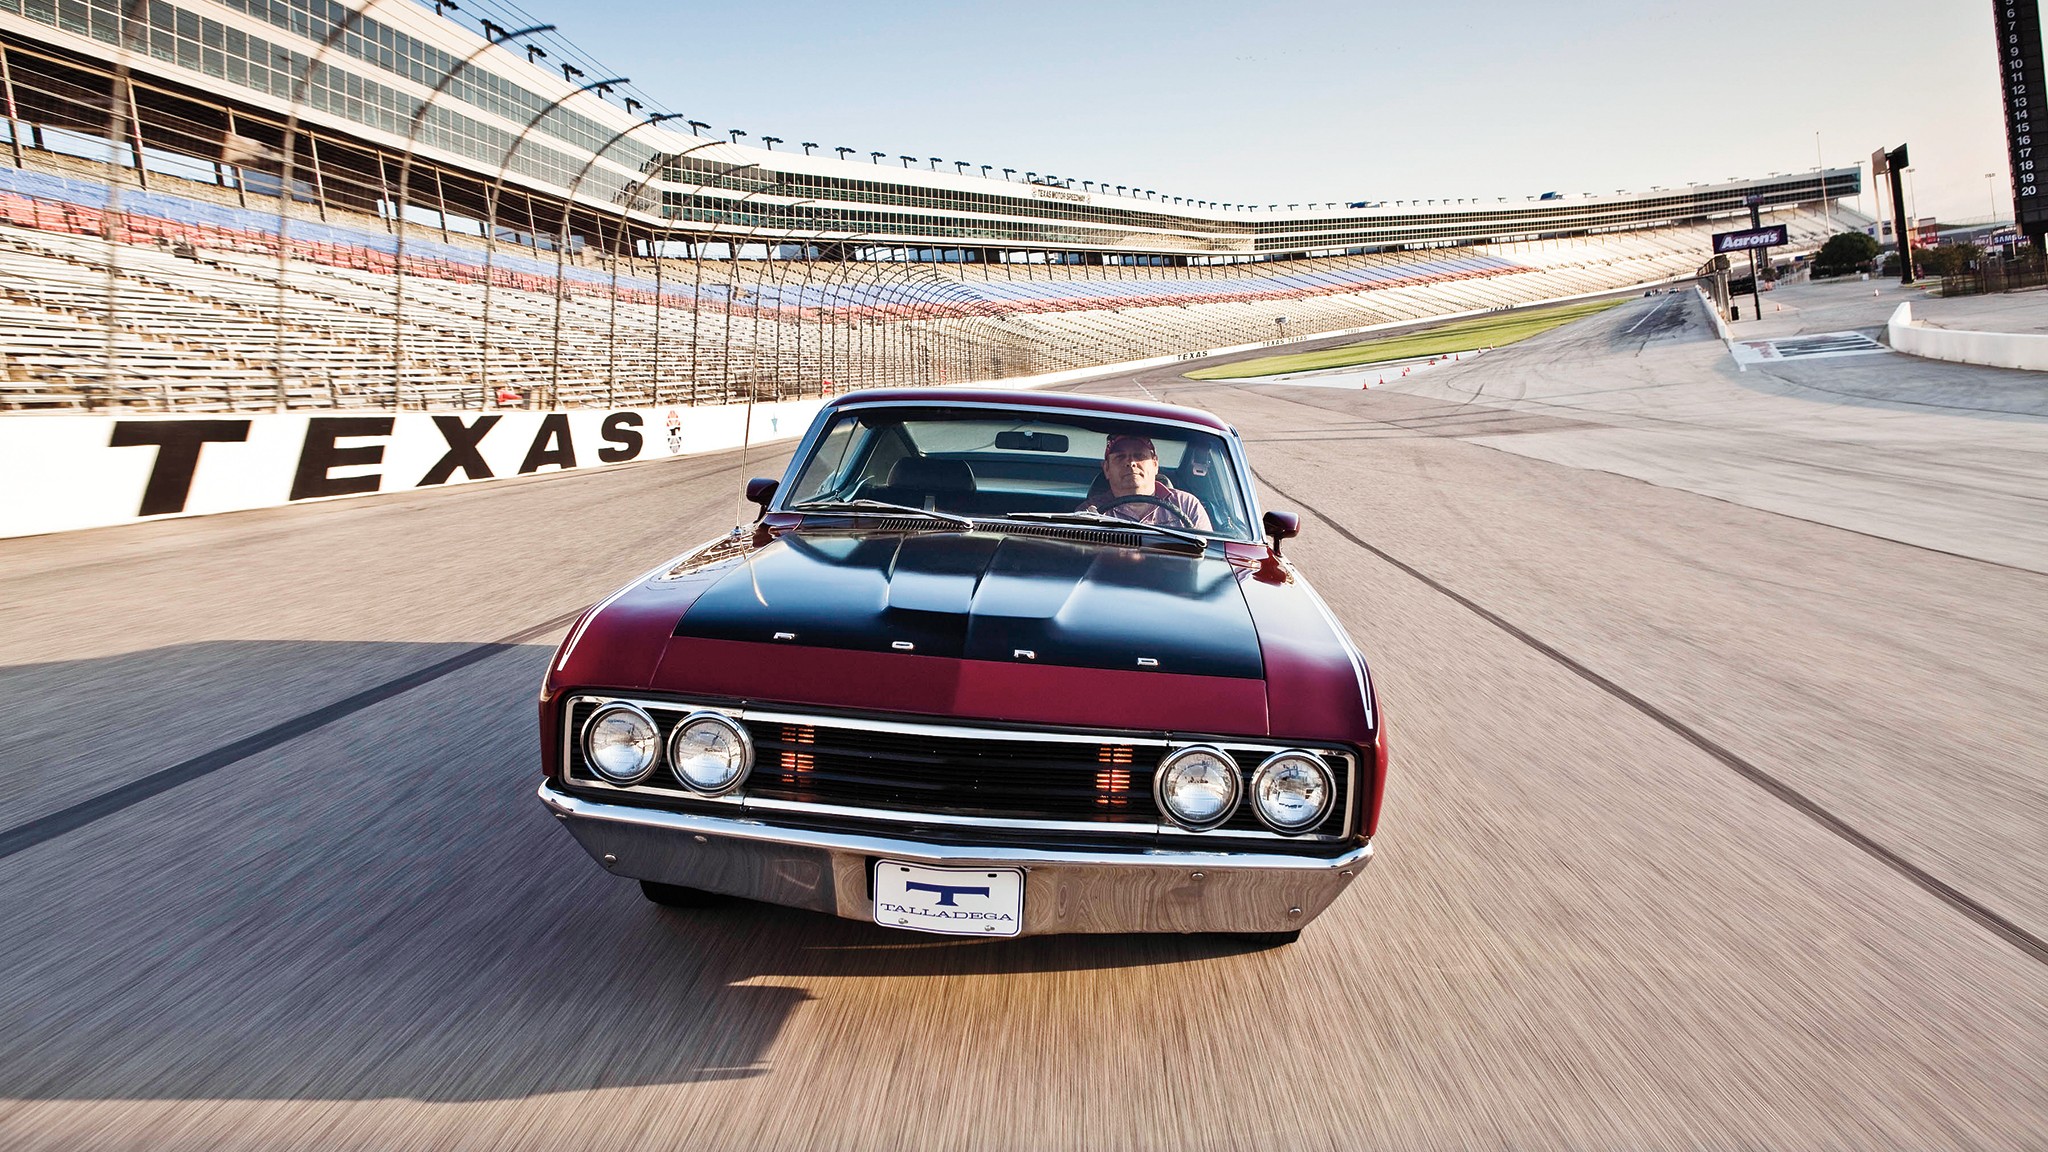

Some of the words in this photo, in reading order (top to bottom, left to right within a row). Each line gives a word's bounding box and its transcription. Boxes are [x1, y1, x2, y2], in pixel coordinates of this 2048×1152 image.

[2006, 8, 2016, 18] 6
[2007, 21, 2016, 31] 7
[2009, 34, 2018, 44] 8
[2010, 46, 2019, 57] 9
[2009, 59, 2023, 69] 10
[2011, 71, 2024, 82] 11
[2012, 84, 2026, 95] 12
[2013, 97, 2028, 108] 13
[2015, 109, 2028, 120] 14
[2015, 122, 2030, 133] 15
[2017, 135, 2031, 146] 16
[2018, 147, 2032, 158] 17
[2019, 160, 2034, 171] 18
[2020, 172, 2035, 184] 19
[1038, 189, 1051, 198] TEXAS
[1052, 191, 1066, 200] MOTOR
[1066, 192, 1086, 202] SPEEDWAY
[2021, 185, 2037, 197] 20
[1721, 232, 1778, 249] Aaron's
[1262, 339, 1284, 347] TEXAS
[1177, 351, 1208, 361] TEXAS
[108, 411, 643, 517] TEXAS
[773, 631, 1159, 666] FORD
[905, 880, 990, 907] T
[880, 902, 1014, 922] TALLADEGA
